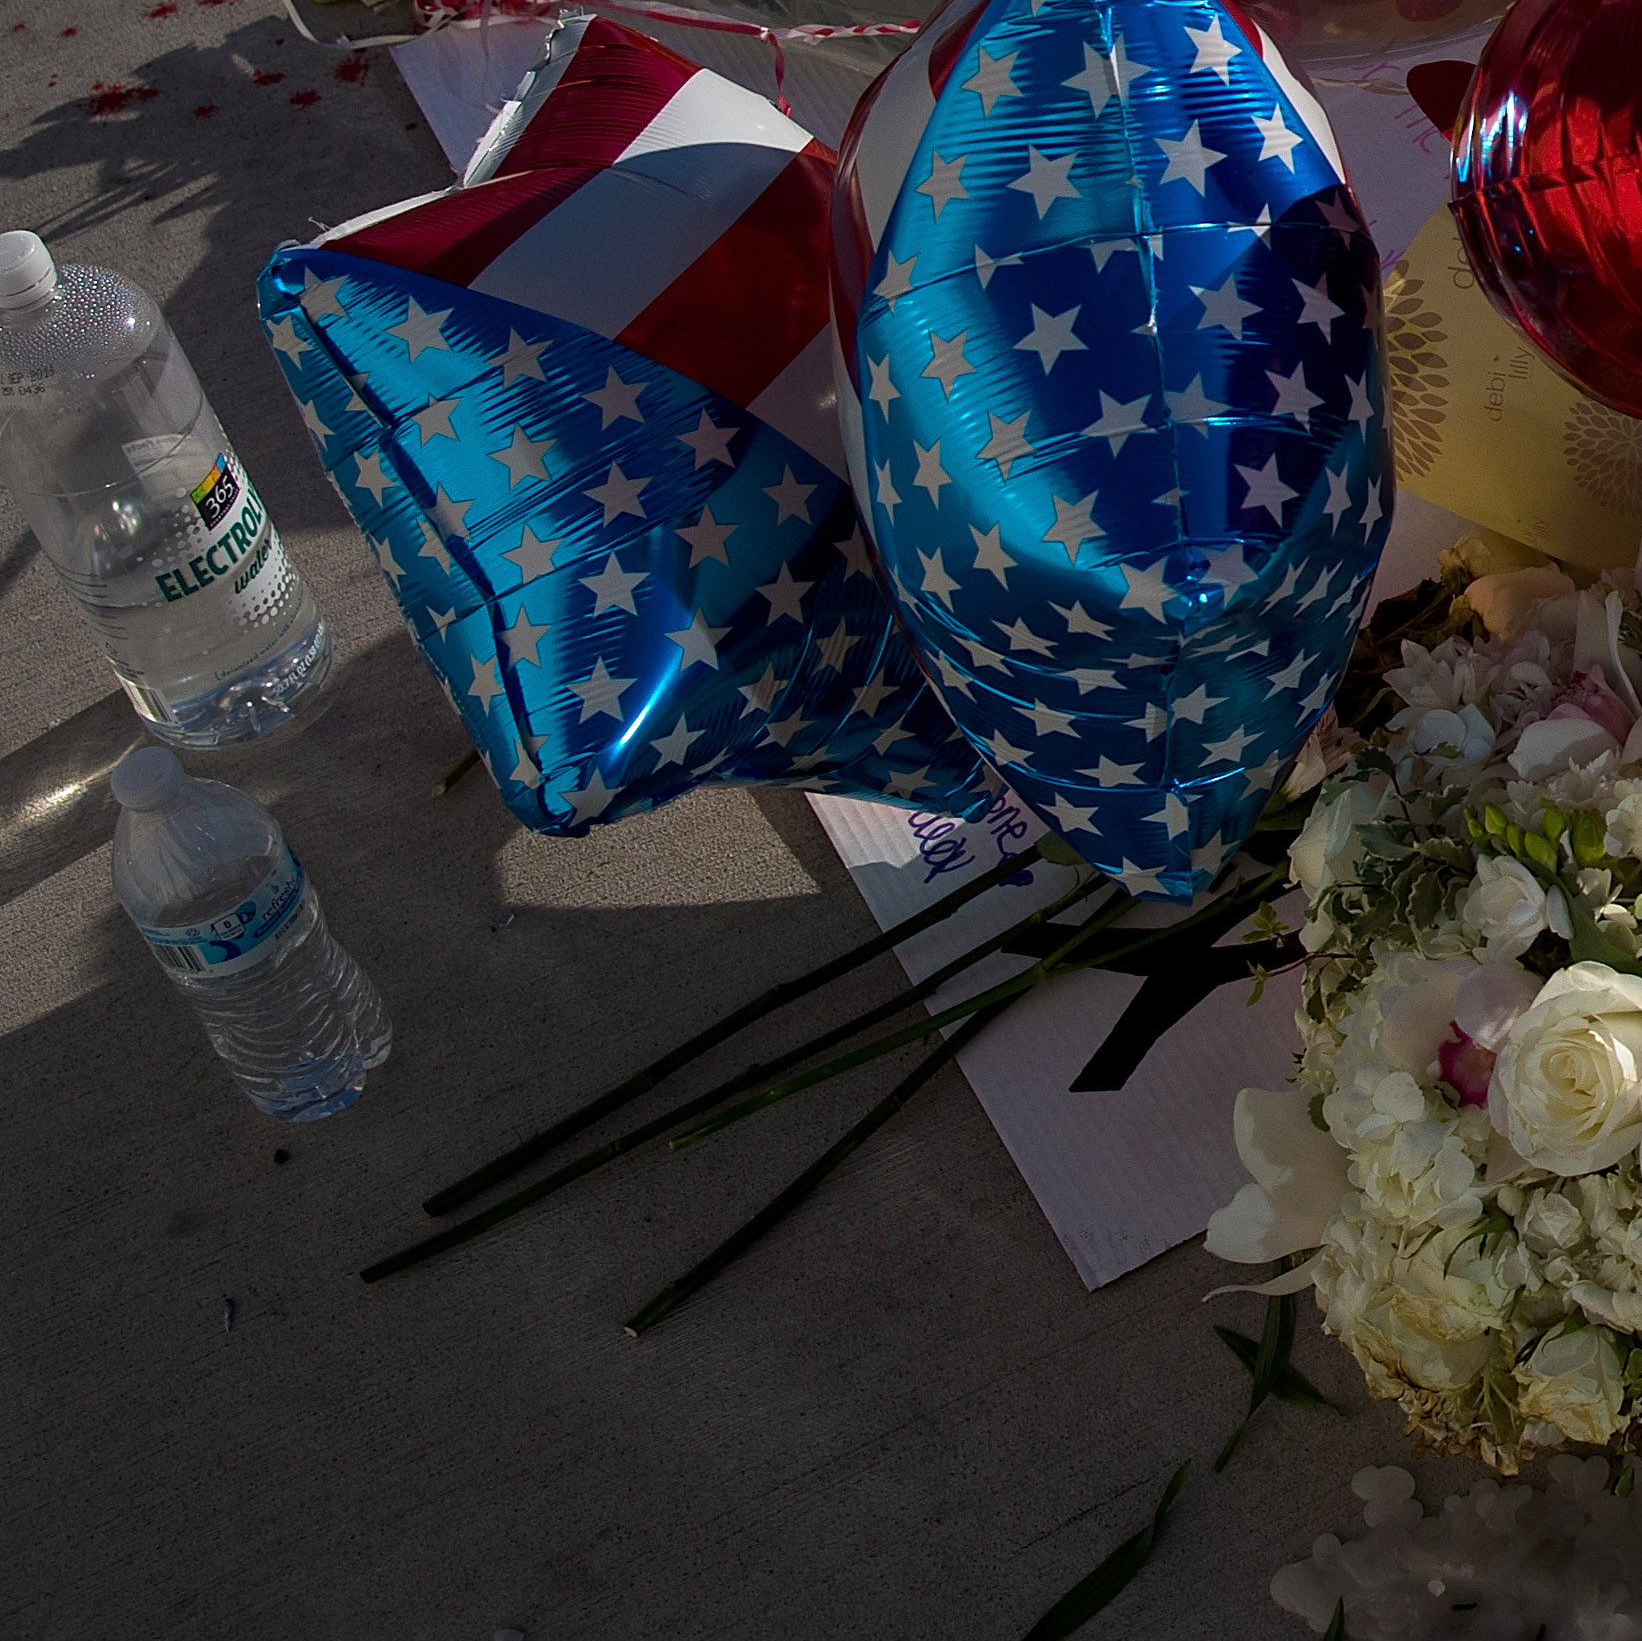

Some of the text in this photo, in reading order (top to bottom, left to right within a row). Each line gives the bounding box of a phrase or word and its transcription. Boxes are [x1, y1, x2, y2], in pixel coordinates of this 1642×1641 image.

[1507, 346, 1536, 380] lilly
[1484, 370, 1507, 422] debi
[203, 474, 236, 521] 365
